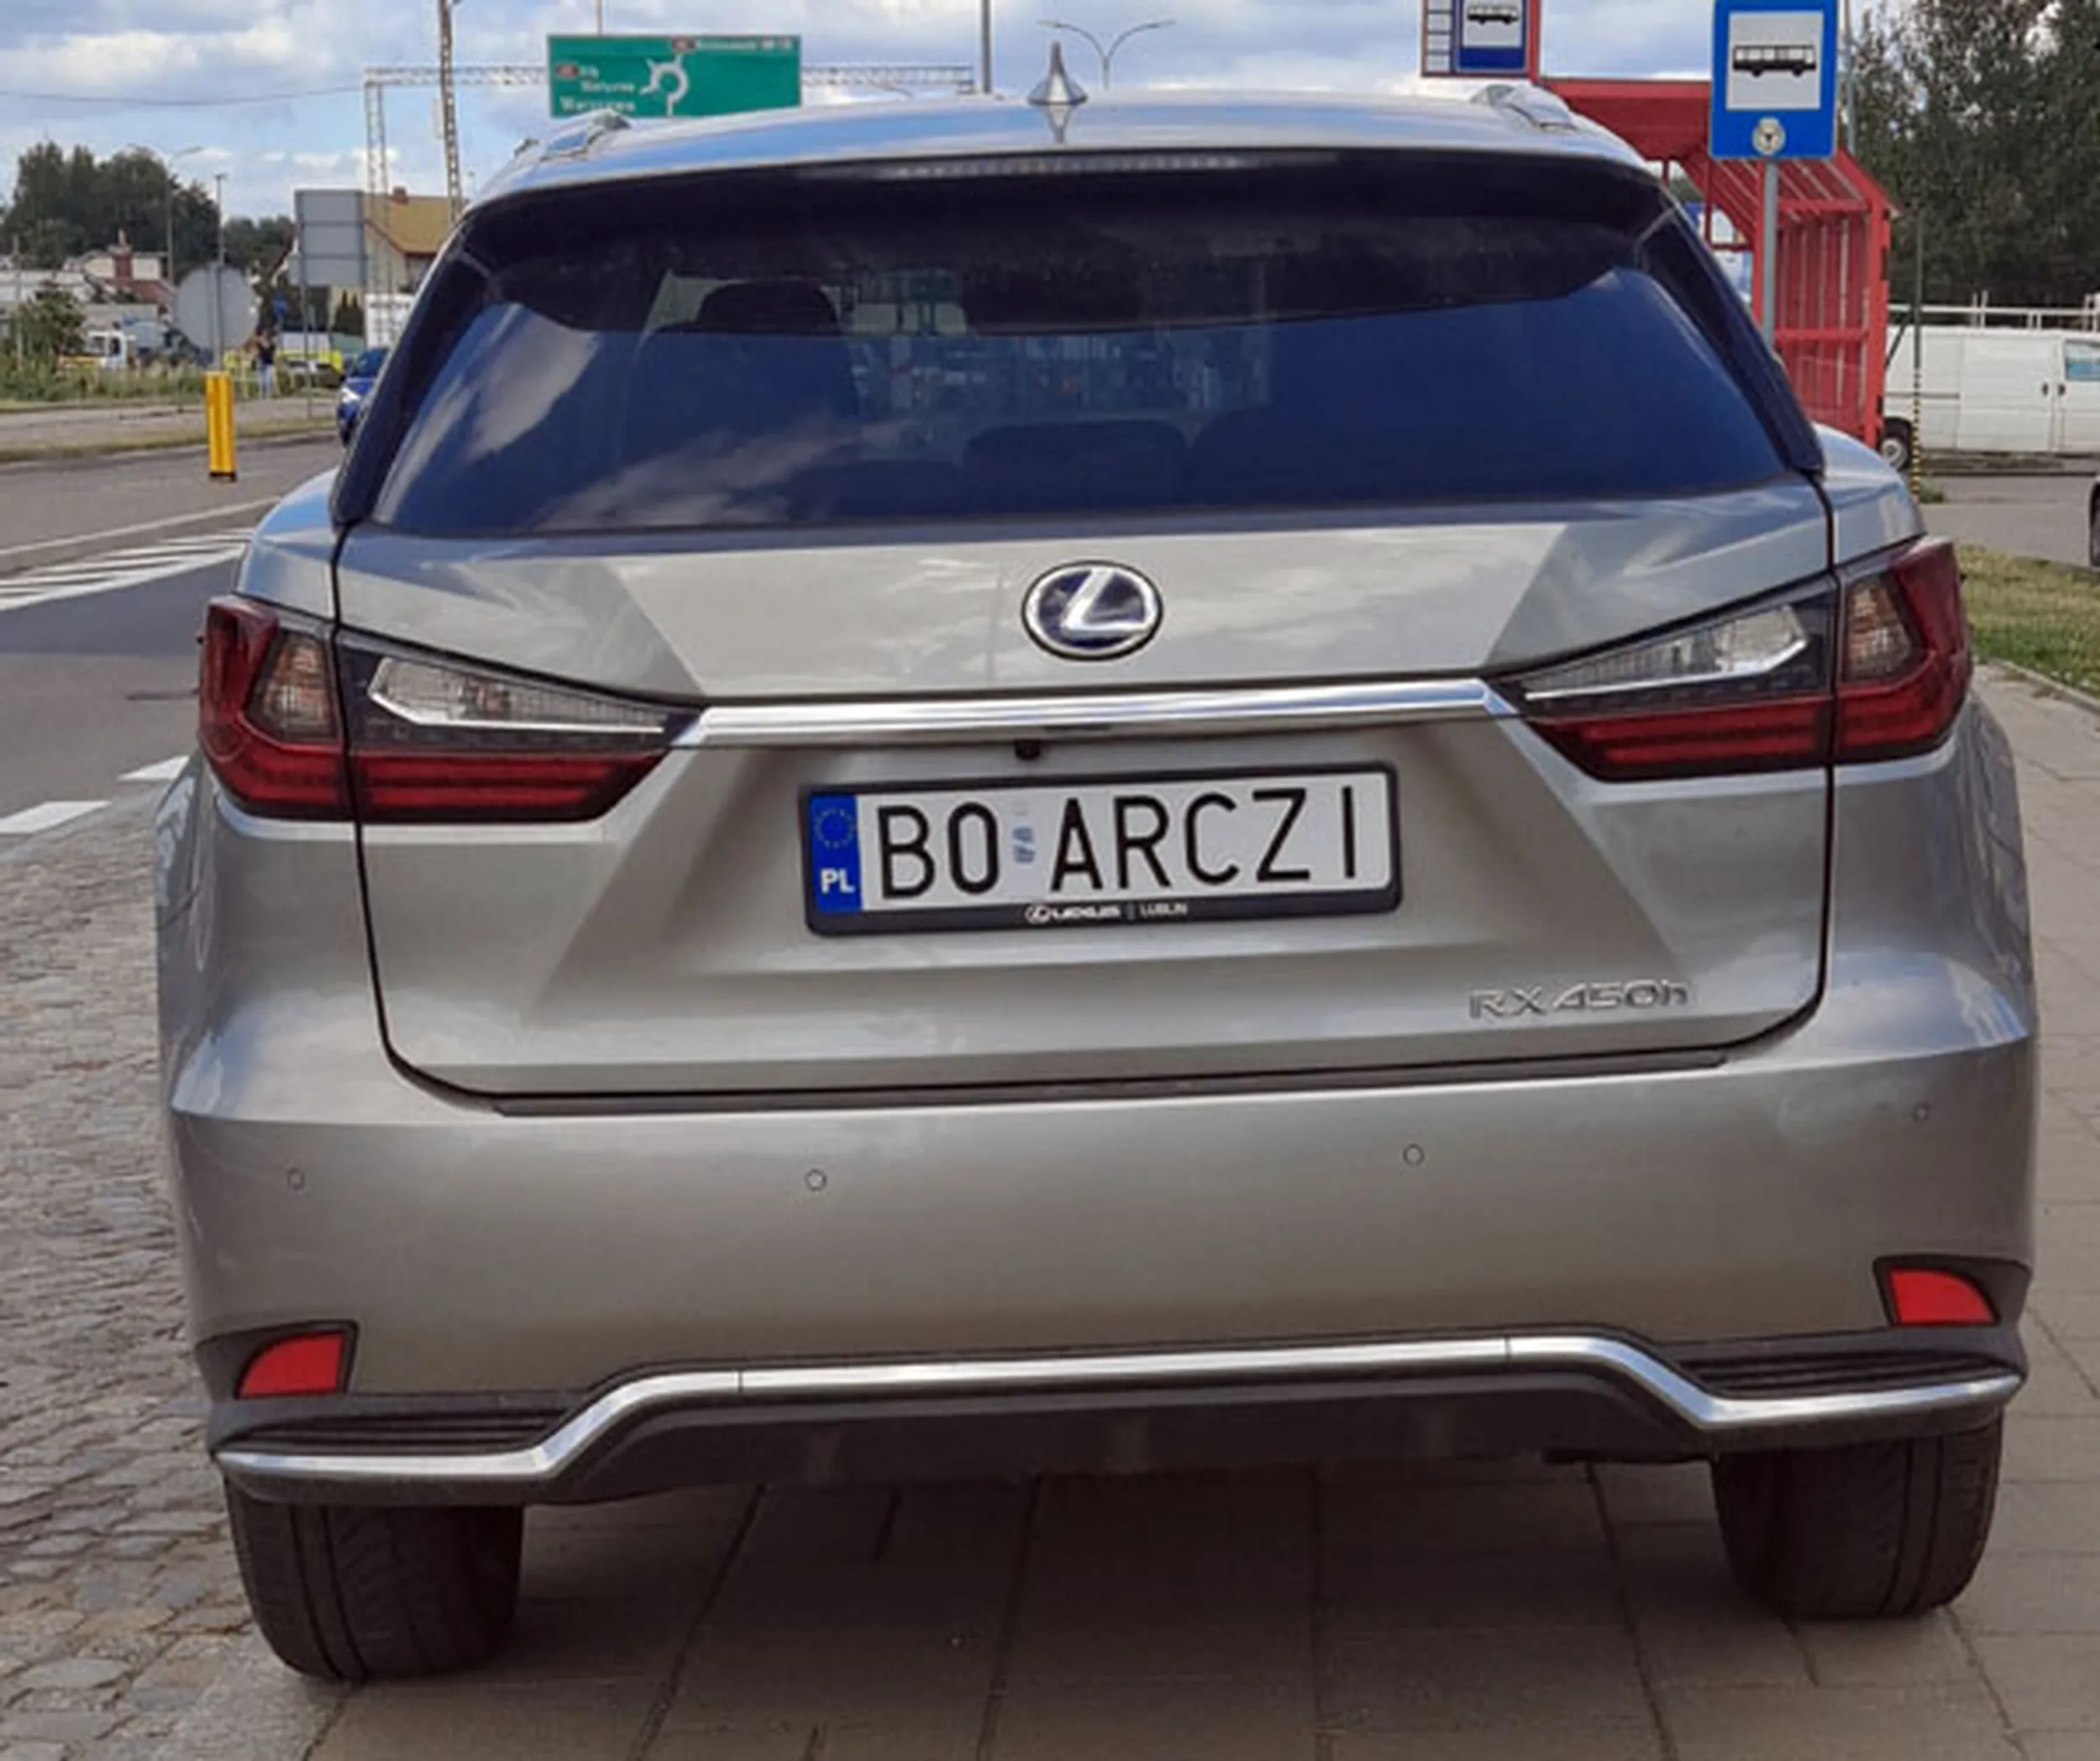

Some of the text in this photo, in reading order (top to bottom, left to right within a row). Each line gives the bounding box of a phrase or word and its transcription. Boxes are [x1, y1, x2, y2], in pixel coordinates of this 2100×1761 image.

[821, 868, 855, 894] PL
[1469, 979, 1689, 1018] RX 450h
